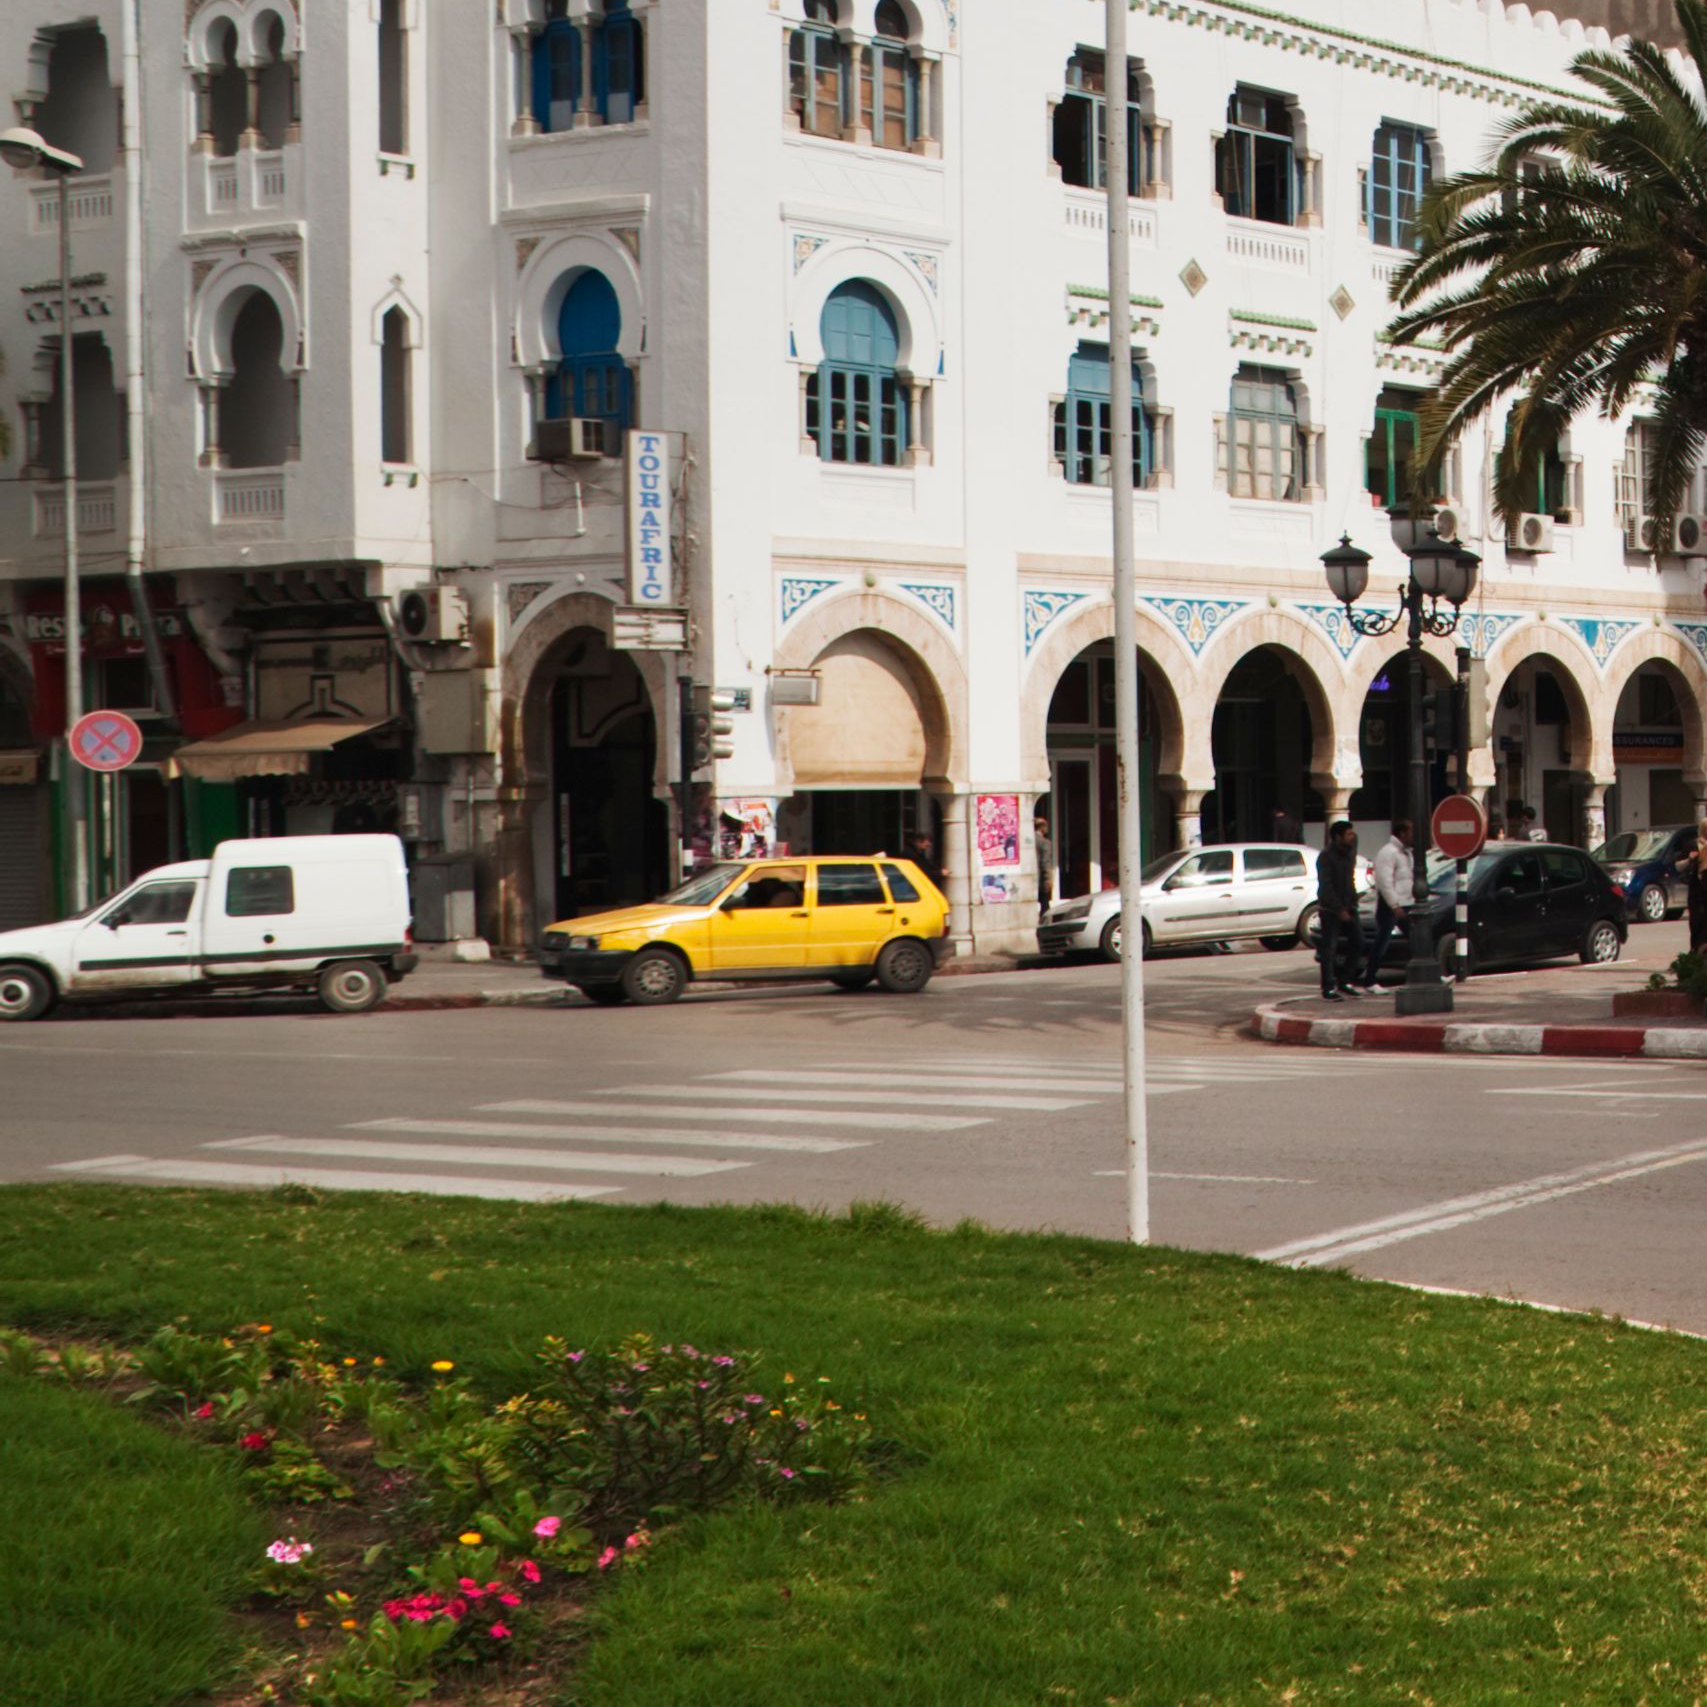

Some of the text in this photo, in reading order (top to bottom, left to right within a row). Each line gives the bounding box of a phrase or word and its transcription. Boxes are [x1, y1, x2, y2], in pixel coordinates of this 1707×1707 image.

[638, 435, 662, 600] TOURAFRIC
[27, 613, 182, 639] Res Pia
[1614, 736, 1675, 746] SSURANCES
